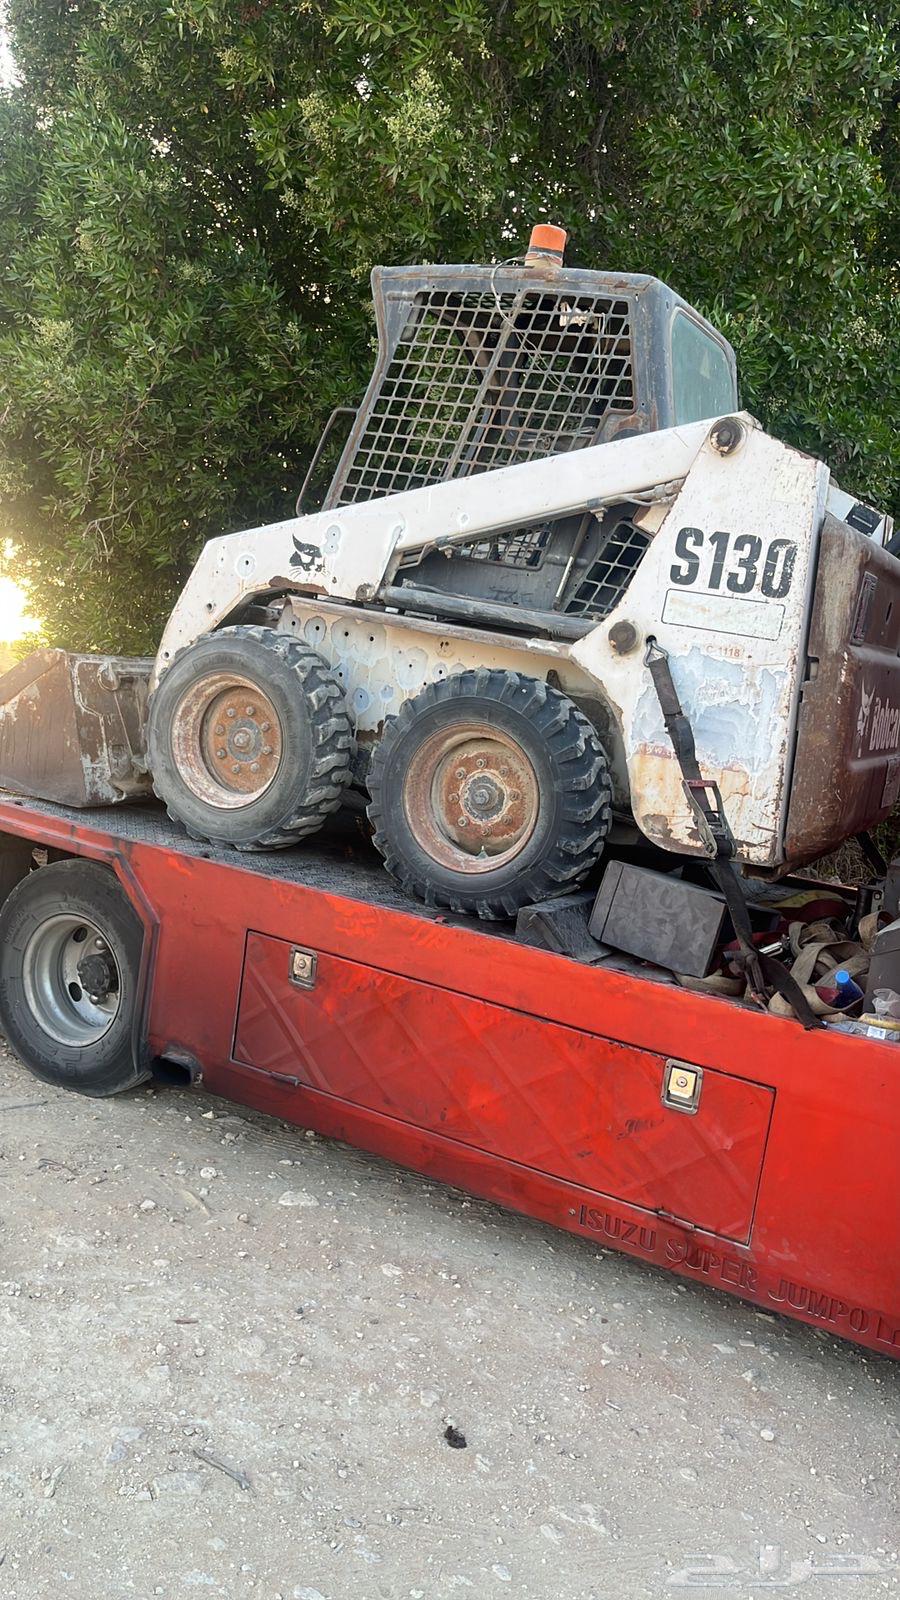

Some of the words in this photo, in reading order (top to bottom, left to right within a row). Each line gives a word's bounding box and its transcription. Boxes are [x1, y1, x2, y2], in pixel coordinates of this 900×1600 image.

[669, 527, 799, 599] S130
[868, 697, 900, 751] Bobca
[578, 1204, 657, 1253] ISUZU
[664, 1238, 761, 1293] SUPER
[767, 1279, 870, 1334] JUMPO
